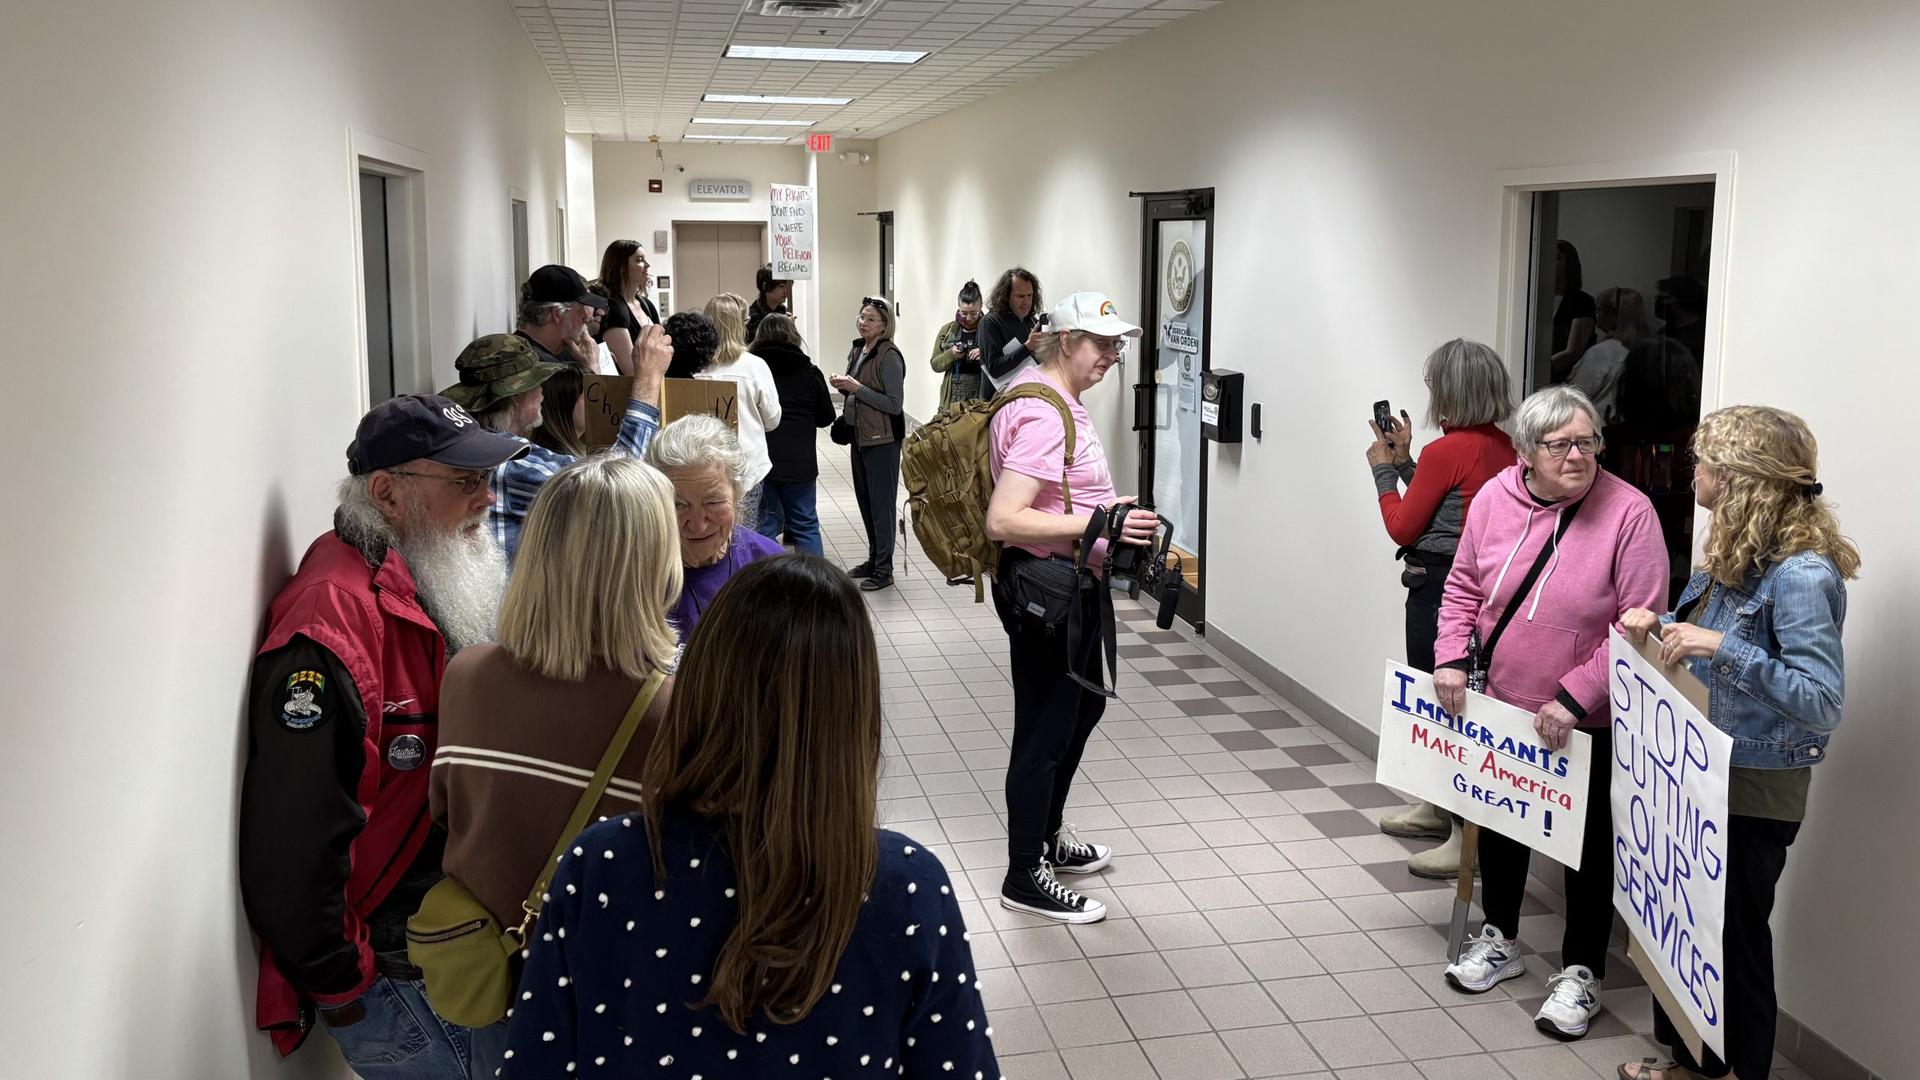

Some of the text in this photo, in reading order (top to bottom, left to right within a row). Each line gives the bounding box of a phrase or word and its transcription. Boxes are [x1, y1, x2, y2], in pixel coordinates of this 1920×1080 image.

[811, 135, 831, 151] EXIT
[697, 184, 744, 195] ELEVATOR
[770, 188, 810, 201] MY RIGHTS
[789, 207, 805, 217] END
[778, 223, 804, 233] WHERE
[775, 234, 793, 247] YOUR
[782, 247, 812, 261] RELIGION
[777, 261, 808, 273] BEGINS
[1180, 336, 1199, 348] ORDEN
[1391, 670, 1569, 778] IMMIGRANTS
[1612, 658, 1709, 786] STOP
[1411, 723, 1572, 811] MAKE America
[1453, 772, 1530, 819] GREAT
[1614, 716, 1721, 881] CUTTING
[1630, 794, 1694, 927] OUR
[1616, 836, 1720, 1027] SERVICES
